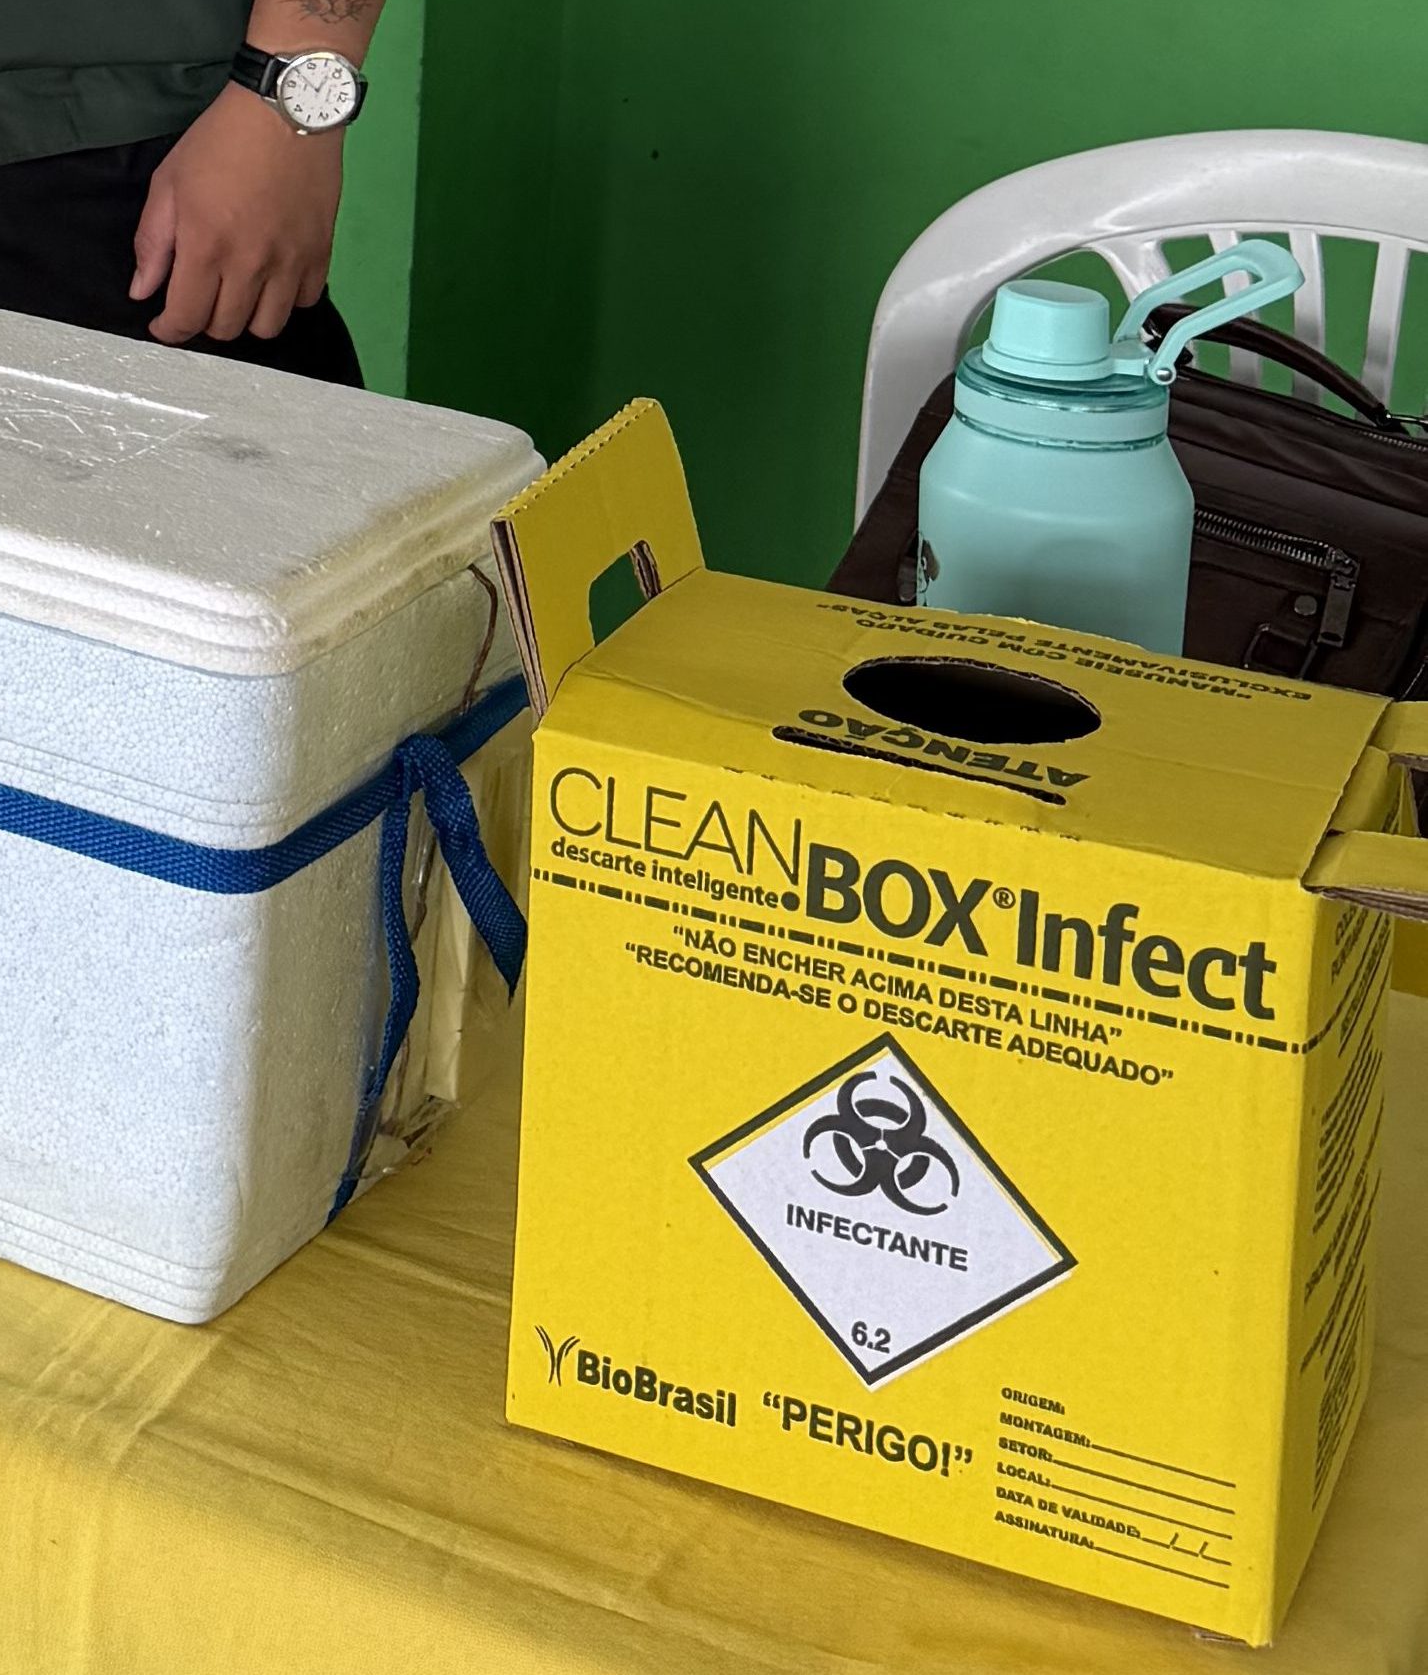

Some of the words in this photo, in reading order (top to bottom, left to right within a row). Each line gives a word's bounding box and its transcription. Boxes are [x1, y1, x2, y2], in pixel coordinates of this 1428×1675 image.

[856, 618, 980, 646] CUIDADO
[992, 641, 1066, 666] COM
[1036, 638, 1312, 701] EXCLUSIVAMENTE
[798, 709, 1092, 788] ATENÇÃO
[551, 837, 646, 879] descarte
[1019, 891, 1277, 1021] Infect
[744, 947, 845, 985] ENCHER
[850, 968, 932, 1004] ACIMA
[938, 987, 1024, 1023] DESTA
[838, 992, 857, 1015] O
[863, 998, 1001, 1049] DESCARTE
[786, 1203, 969, 1272] INFECTANTE
[851, 1320, 892, 1354] 6.2
[577, 1349, 737, 1427] BioBrasil
[1001, 1387, 1065, 1415] ORIGEM:
[999, 1437, 1053, 1462] SETOR:
[1000, 1412, 1091, 1448] MONTAGEM:
[997, 1462, 1050, 1487] LOCAL:
[996, 1486, 1034, 1508] DATA
[1038, 1499, 1058, 1514] DE
[995, 1510, 1094, 1549] ASSINATURA:
